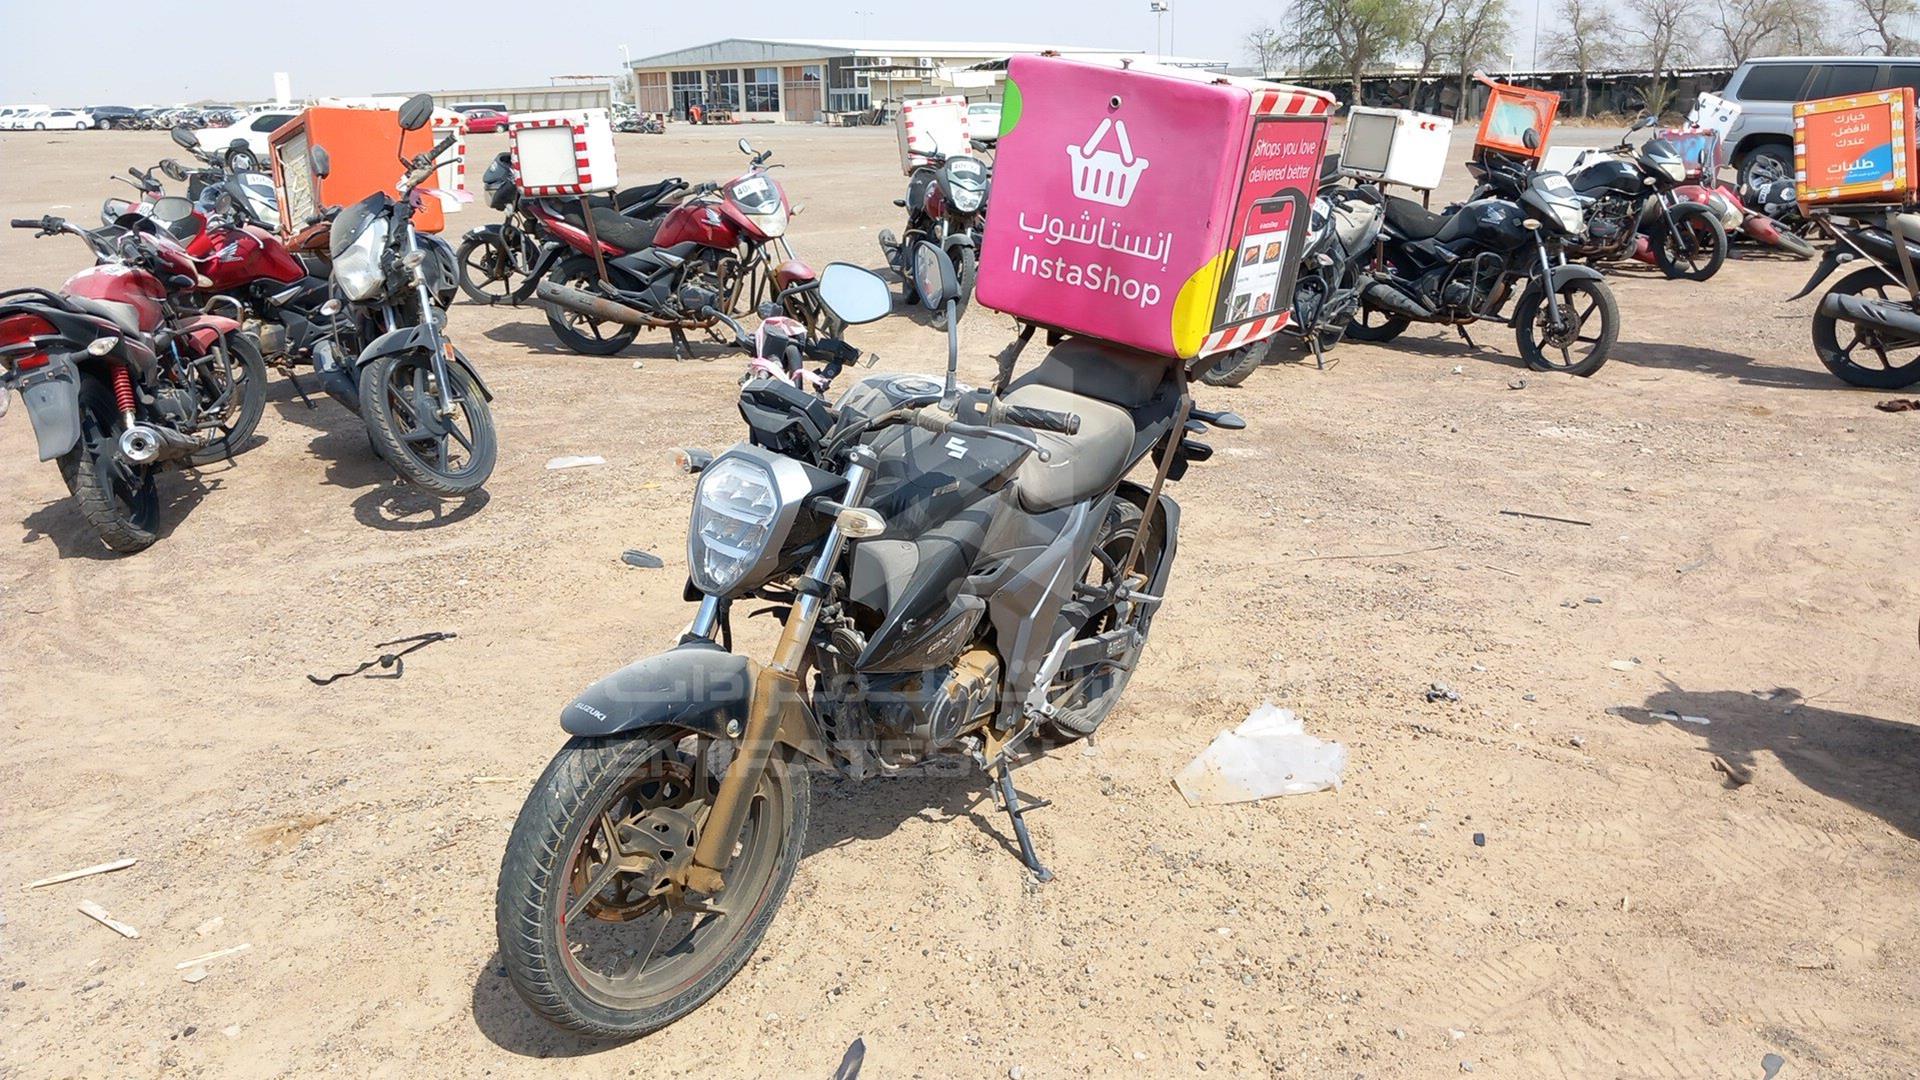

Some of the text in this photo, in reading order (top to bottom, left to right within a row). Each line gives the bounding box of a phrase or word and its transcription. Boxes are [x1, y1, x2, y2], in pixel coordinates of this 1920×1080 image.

[1254, 139, 1317, 158] Shops you love
[1248, 164, 1311, 183] delivered better
[1827, 158, 1875, 174] طلبات
[1018, 209, 1173, 273] إنستاشوب
[1011, 246, 1161, 309] InstaShop
[575, 702, 607, 722] SUZUKI
